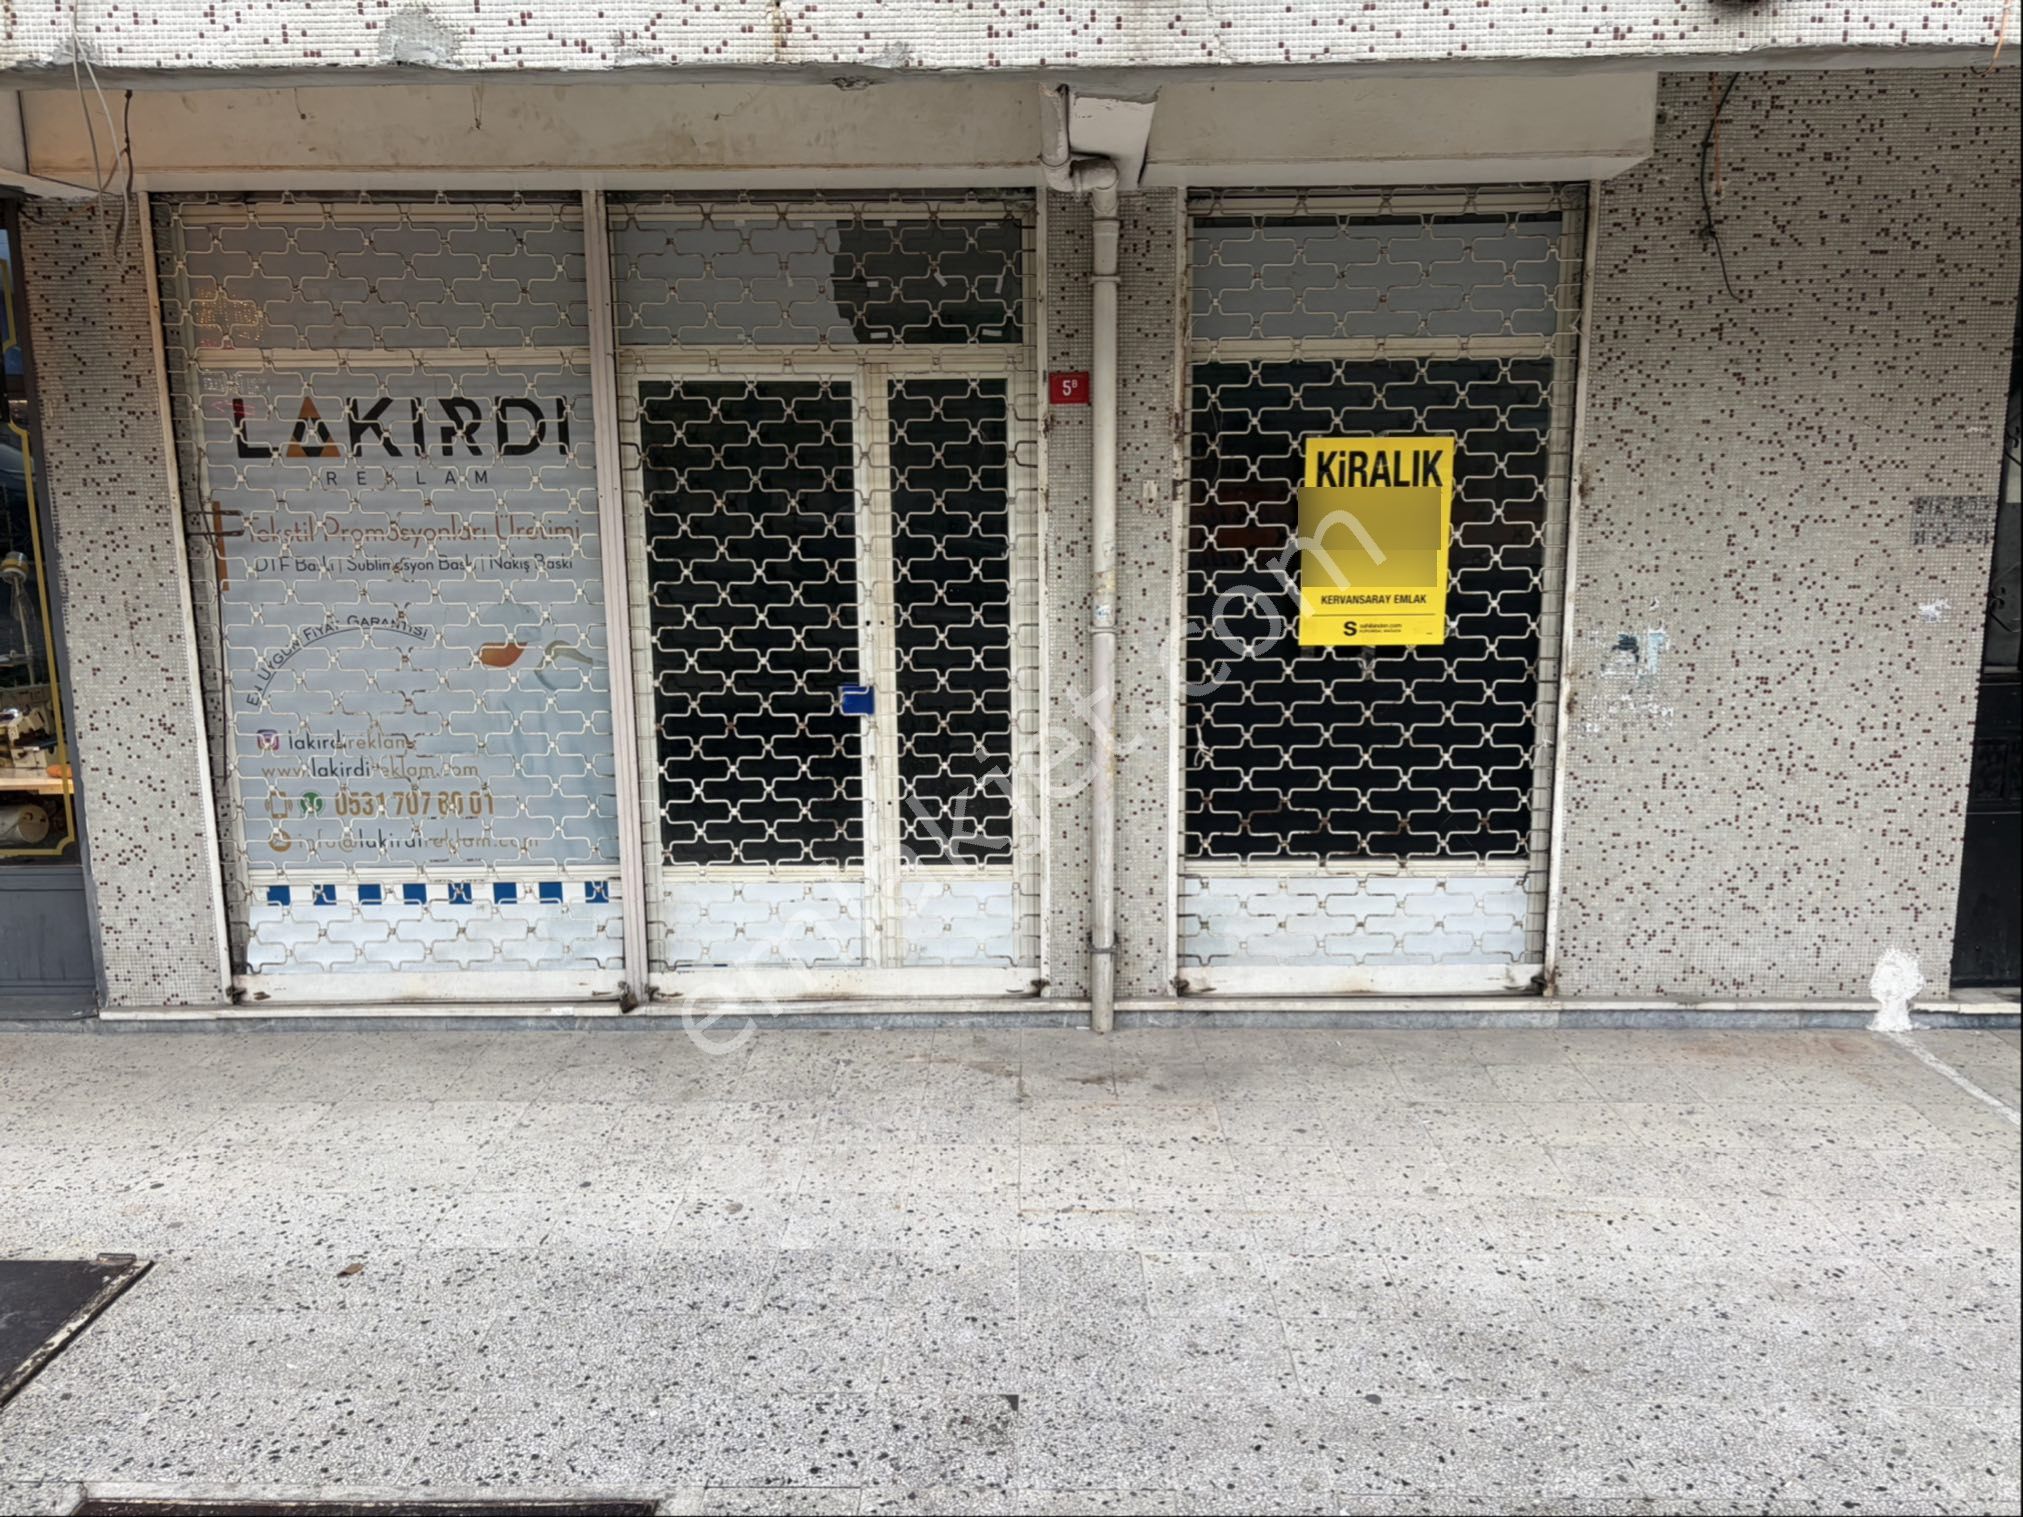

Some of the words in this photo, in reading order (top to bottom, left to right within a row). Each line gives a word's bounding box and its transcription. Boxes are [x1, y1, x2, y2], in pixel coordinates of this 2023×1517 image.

[232, 396, 570, 459] LAKIRDI
[295, 555, 335, 573] Bakı
[490, 553, 531, 573] Nakış
[1321, 595, 1391, 604] KERVANSARAY
[1394, 595, 1427, 604] EMLAK
[262, 755, 478, 777] www.lakirdieklam.com
[392, 791, 432, 816] 707
